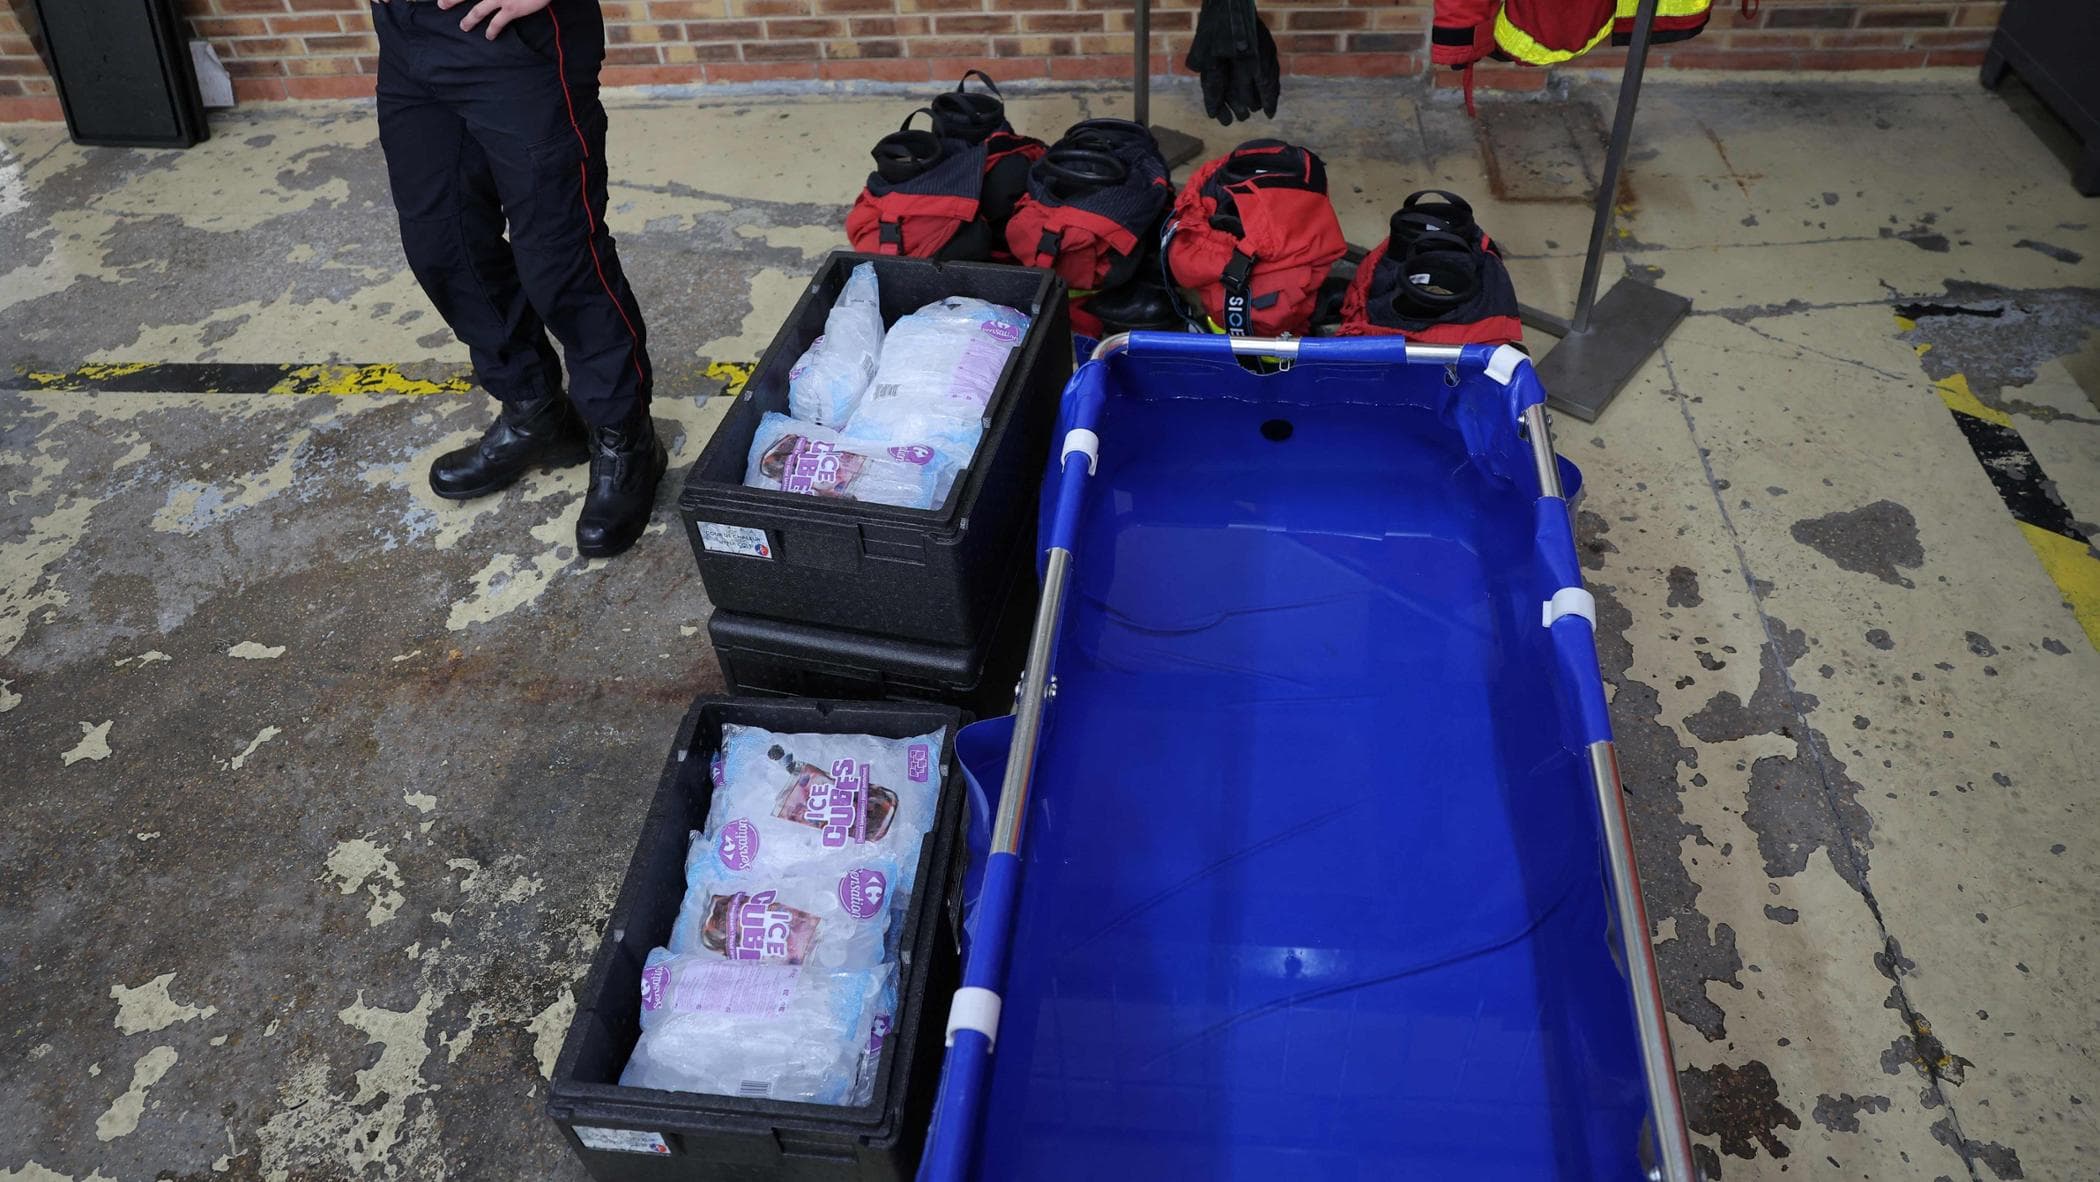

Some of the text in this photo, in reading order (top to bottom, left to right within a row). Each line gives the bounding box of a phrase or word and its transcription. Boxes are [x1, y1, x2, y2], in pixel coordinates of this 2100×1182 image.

[817, 449, 841, 482] CE
[804, 783, 829, 821] ICE
[821, 757, 861, 850] CUBES
[735, 818, 753, 873] Sensation
[764, 911, 793, 958] ICE
